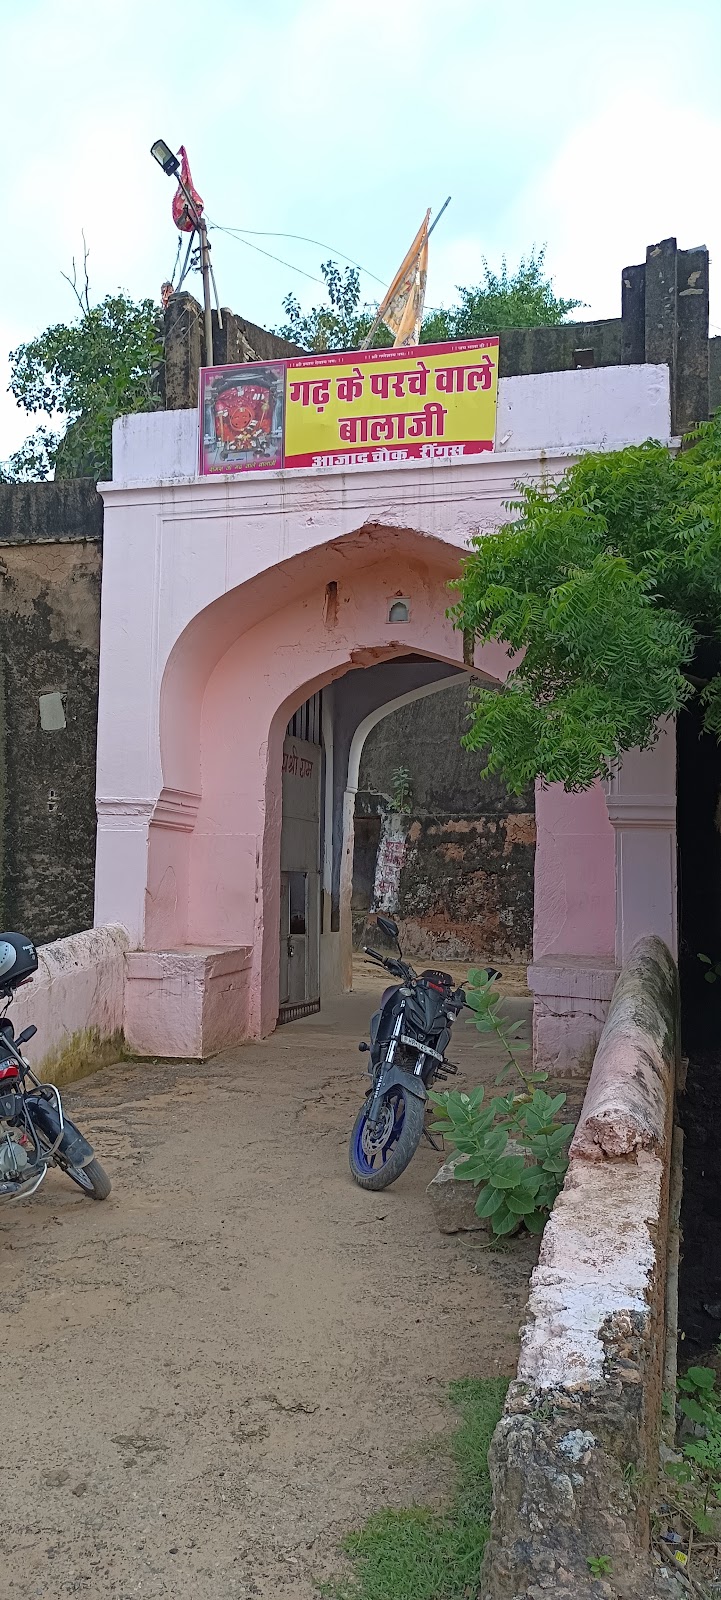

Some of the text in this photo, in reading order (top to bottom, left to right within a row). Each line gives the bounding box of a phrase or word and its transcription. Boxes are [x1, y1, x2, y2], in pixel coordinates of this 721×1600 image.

[289, 355, 496, 412] गढ़ के परचे वाले
[338, 402, 448, 443] बालाजी
[311, 452, 370, 467] आजाद
[299, 758, 314, 778] राम
